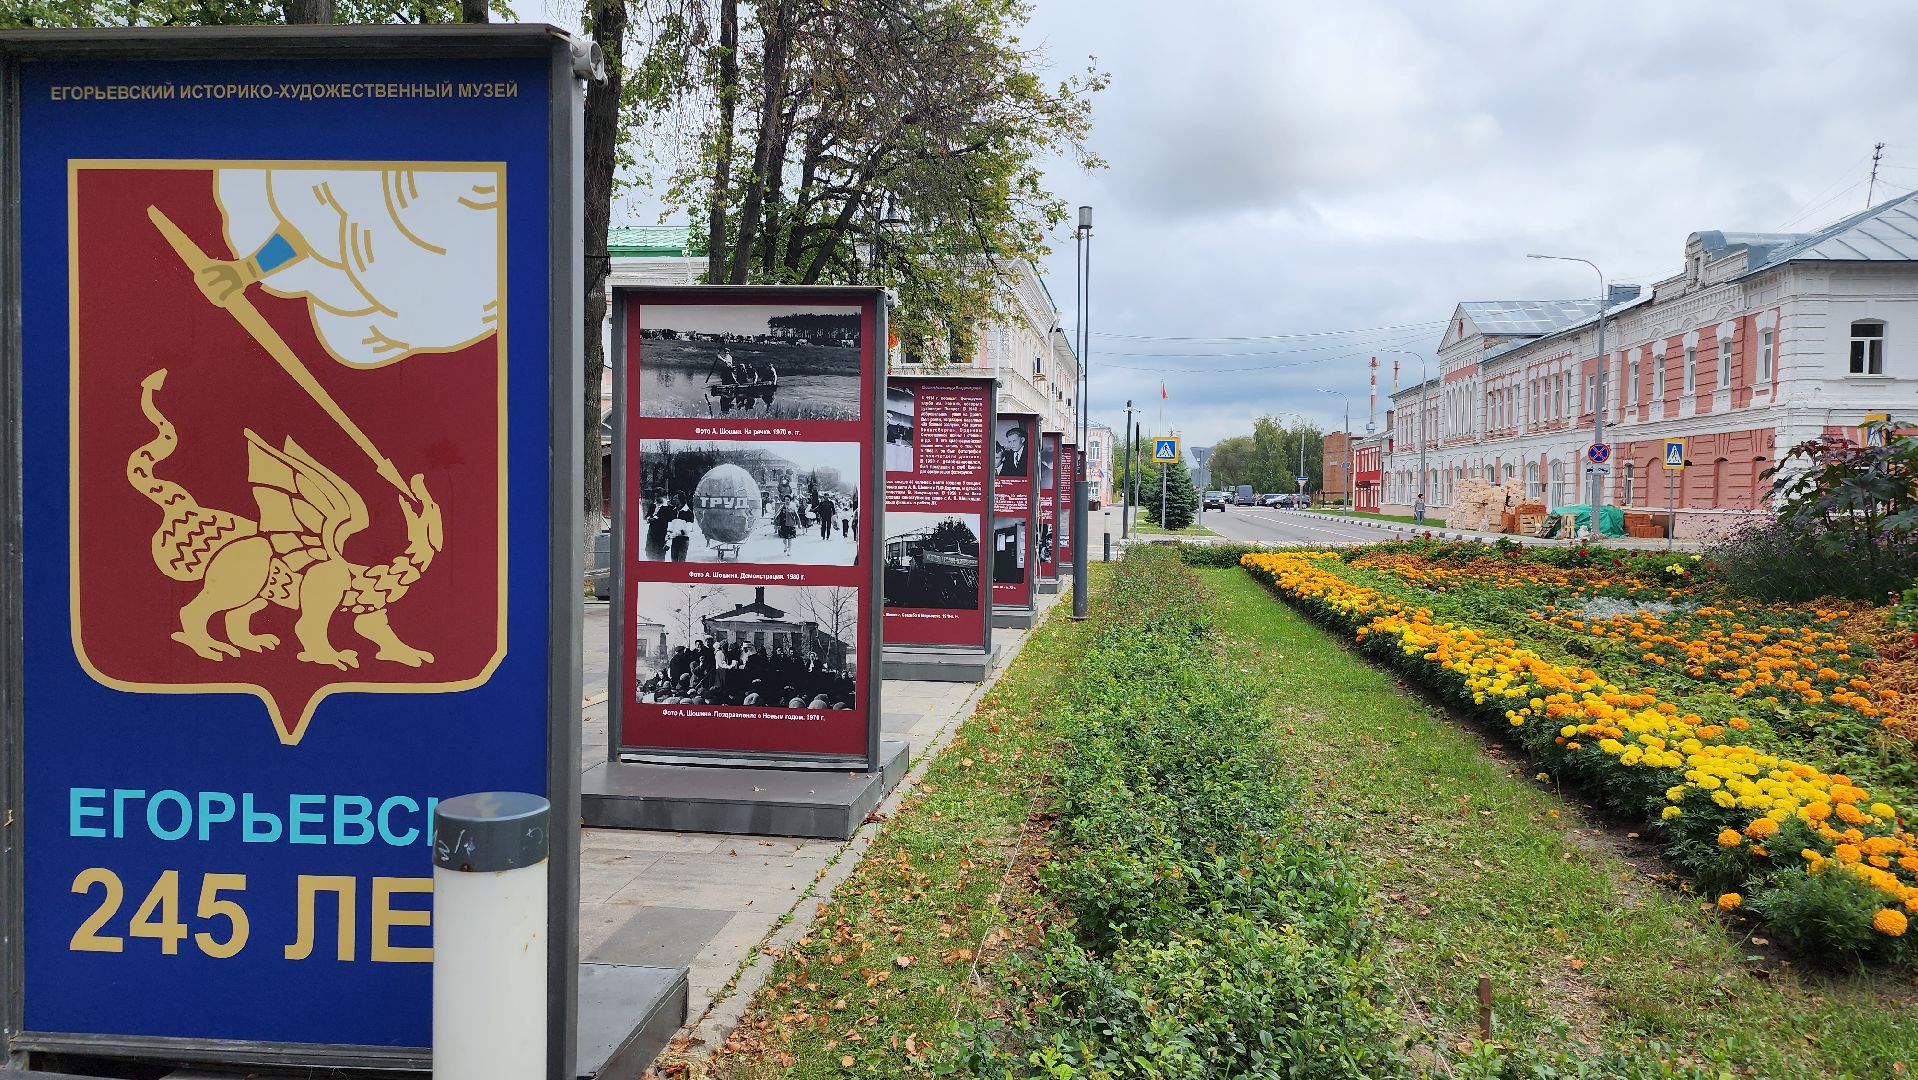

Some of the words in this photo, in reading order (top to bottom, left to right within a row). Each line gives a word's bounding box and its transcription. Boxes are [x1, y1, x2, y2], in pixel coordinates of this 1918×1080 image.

[51, 82, 175, 100] ЕГОРЬЕВСКИЙ
[180, 80, 452, 101] ИСТОРИКО-ХУДОЖЕСТВЕННЫЙ
[458, 80, 518, 98] МУЗЕЙ
[700, 497, 750, 509] ТРУД
[69, 867, 250, 959] 245
[284, 874, 434, 963] ЛЕ
